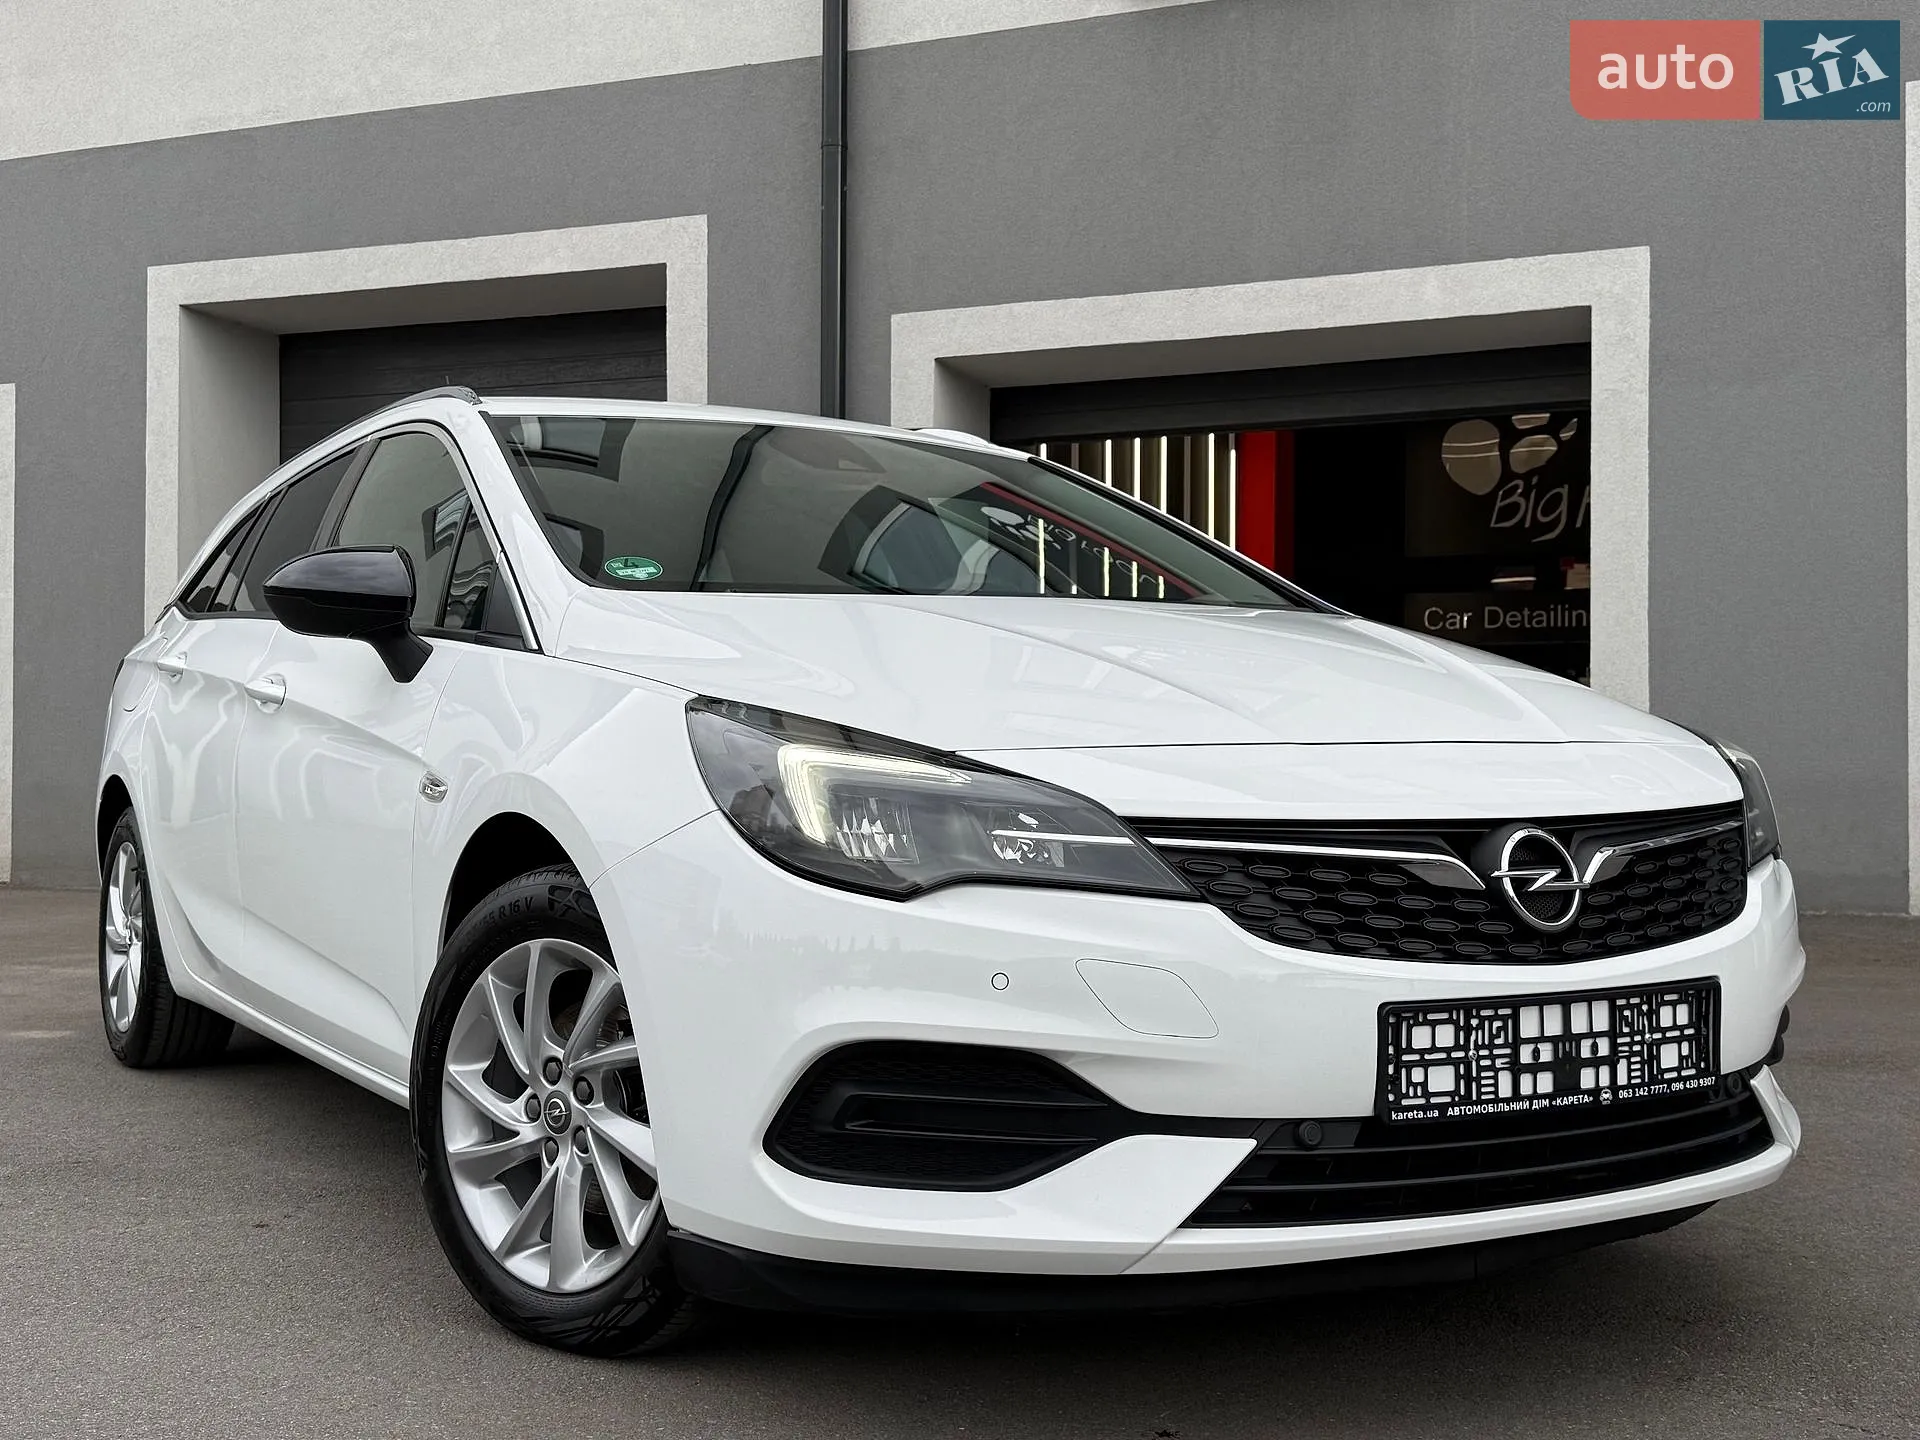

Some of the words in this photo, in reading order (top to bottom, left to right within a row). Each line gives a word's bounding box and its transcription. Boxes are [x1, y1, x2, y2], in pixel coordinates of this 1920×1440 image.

[1490, 475, 1569, 543] Big
[1424, 606, 1472, 630] Car
[1391, 1108, 1439, 1121] kareta.ua
[1446, 1098, 1530, 1117] АВТОМОБІЛЬНИЙ
[1532, 1098, 1550, 1110] ДІМ
[1551, 1093, 1594, 1107] «КАРЕТА»
[1618, 1088, 1633, 1099] 063
[1634, 1086, 1649, 1097] 142
[1650, 1083, 1670, 1094] 7777,
[1671, 1082, 1684, 1091] 096
[1685, 1079, 1698, 1090] 430
[1699, 1076, 1716, 1087] 9307
